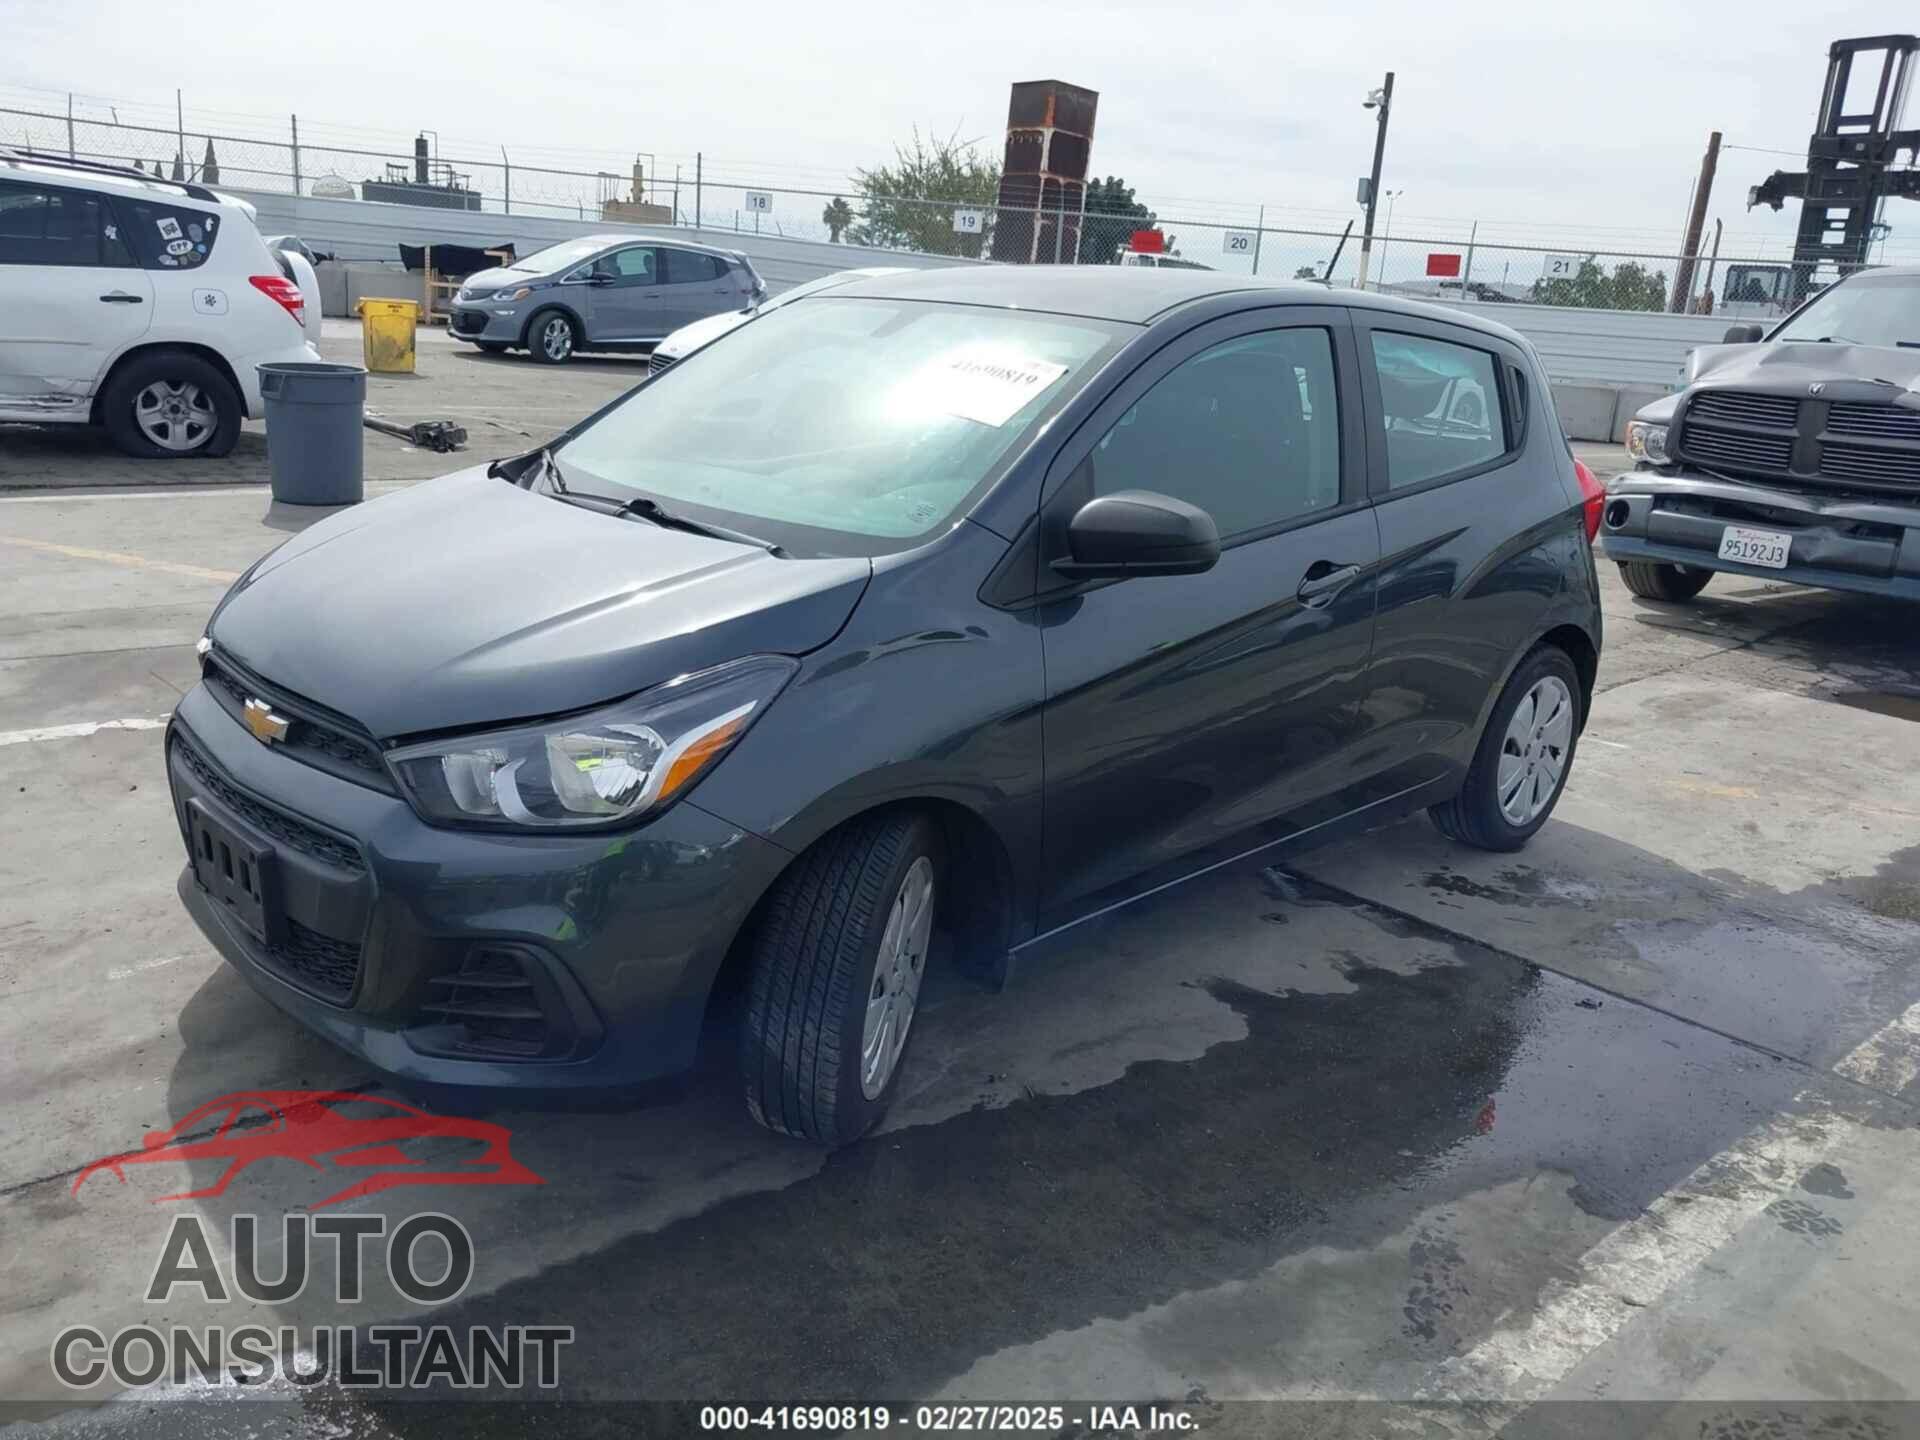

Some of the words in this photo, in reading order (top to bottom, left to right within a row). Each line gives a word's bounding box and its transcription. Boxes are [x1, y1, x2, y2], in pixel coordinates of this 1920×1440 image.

[752, 197, 766, 209] 18
[961, 216, 976, 228] 19
[1230, 237, 1248, 250] 20
[1552, 261, 1570, 273] 21
[1723, 540, 1784, 563] 95192J3
